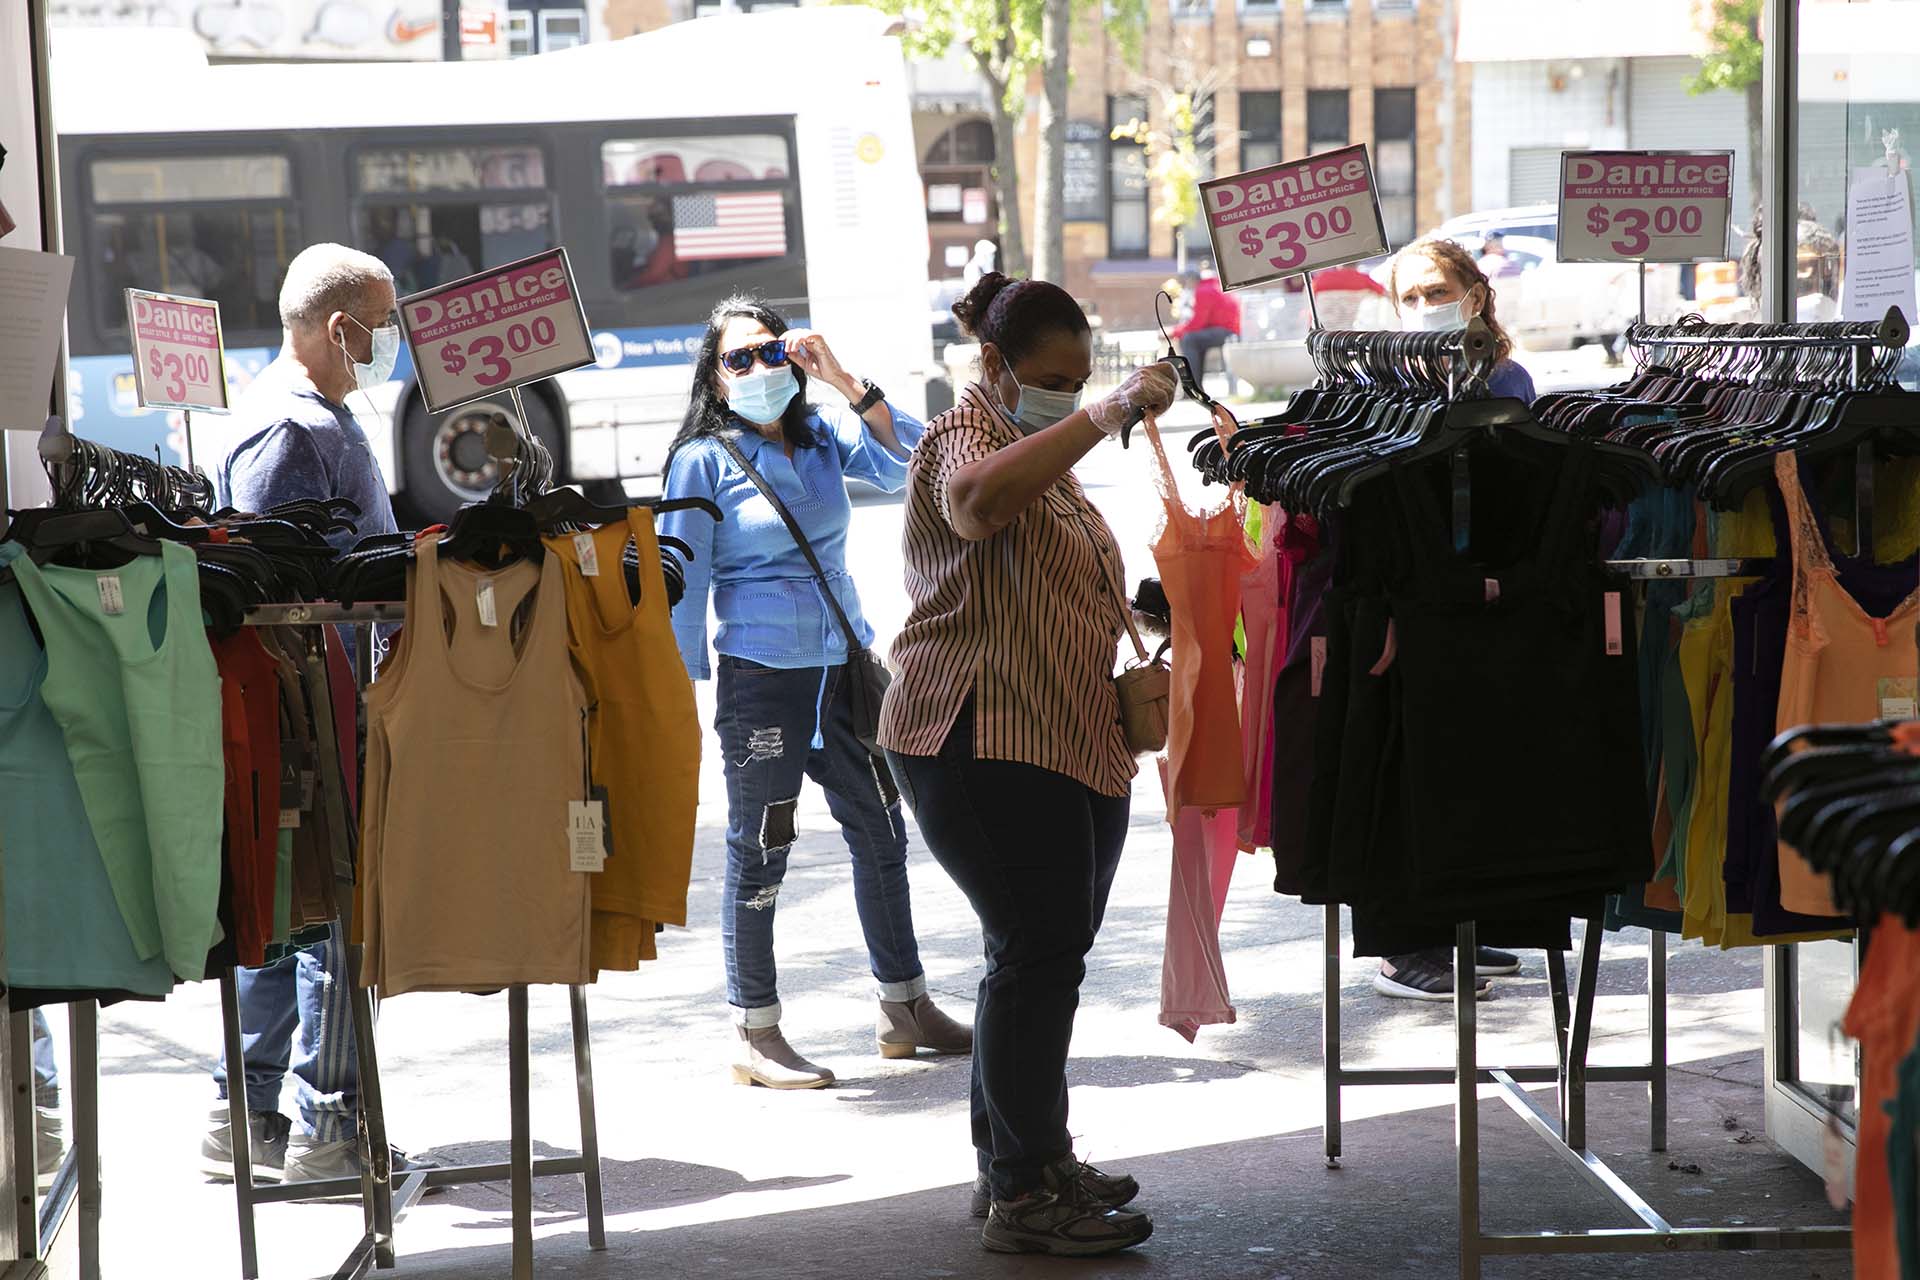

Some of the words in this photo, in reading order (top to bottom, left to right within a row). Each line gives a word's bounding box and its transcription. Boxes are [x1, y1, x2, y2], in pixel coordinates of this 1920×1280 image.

[1207, 160, 1365, 213] Danice
[1566, 158, 1728, 185] Danice
[1221, 209, 1249, 222] GREAT
[1251, 202, 1277, 215] STYLE
[1300, 191, 1328, 203] GREAT
[1329, 183, 1355, 196] PRICE
[1576, 187, 1603, 195] GREAT
[1606, 187, 1632, 195] STYLE
[135, 299, 217, 335] Danice
[405, 267, 564, 330] Danice
[421, 326, 449, 339] GREAT
[451, 317, 478, 330] STYLE
[501, 302, 529, 314] GREAT
[531, 292, 556, 305] PRICE
[624, 341, 654, 356] New
[655, 338, 683, 354] York
